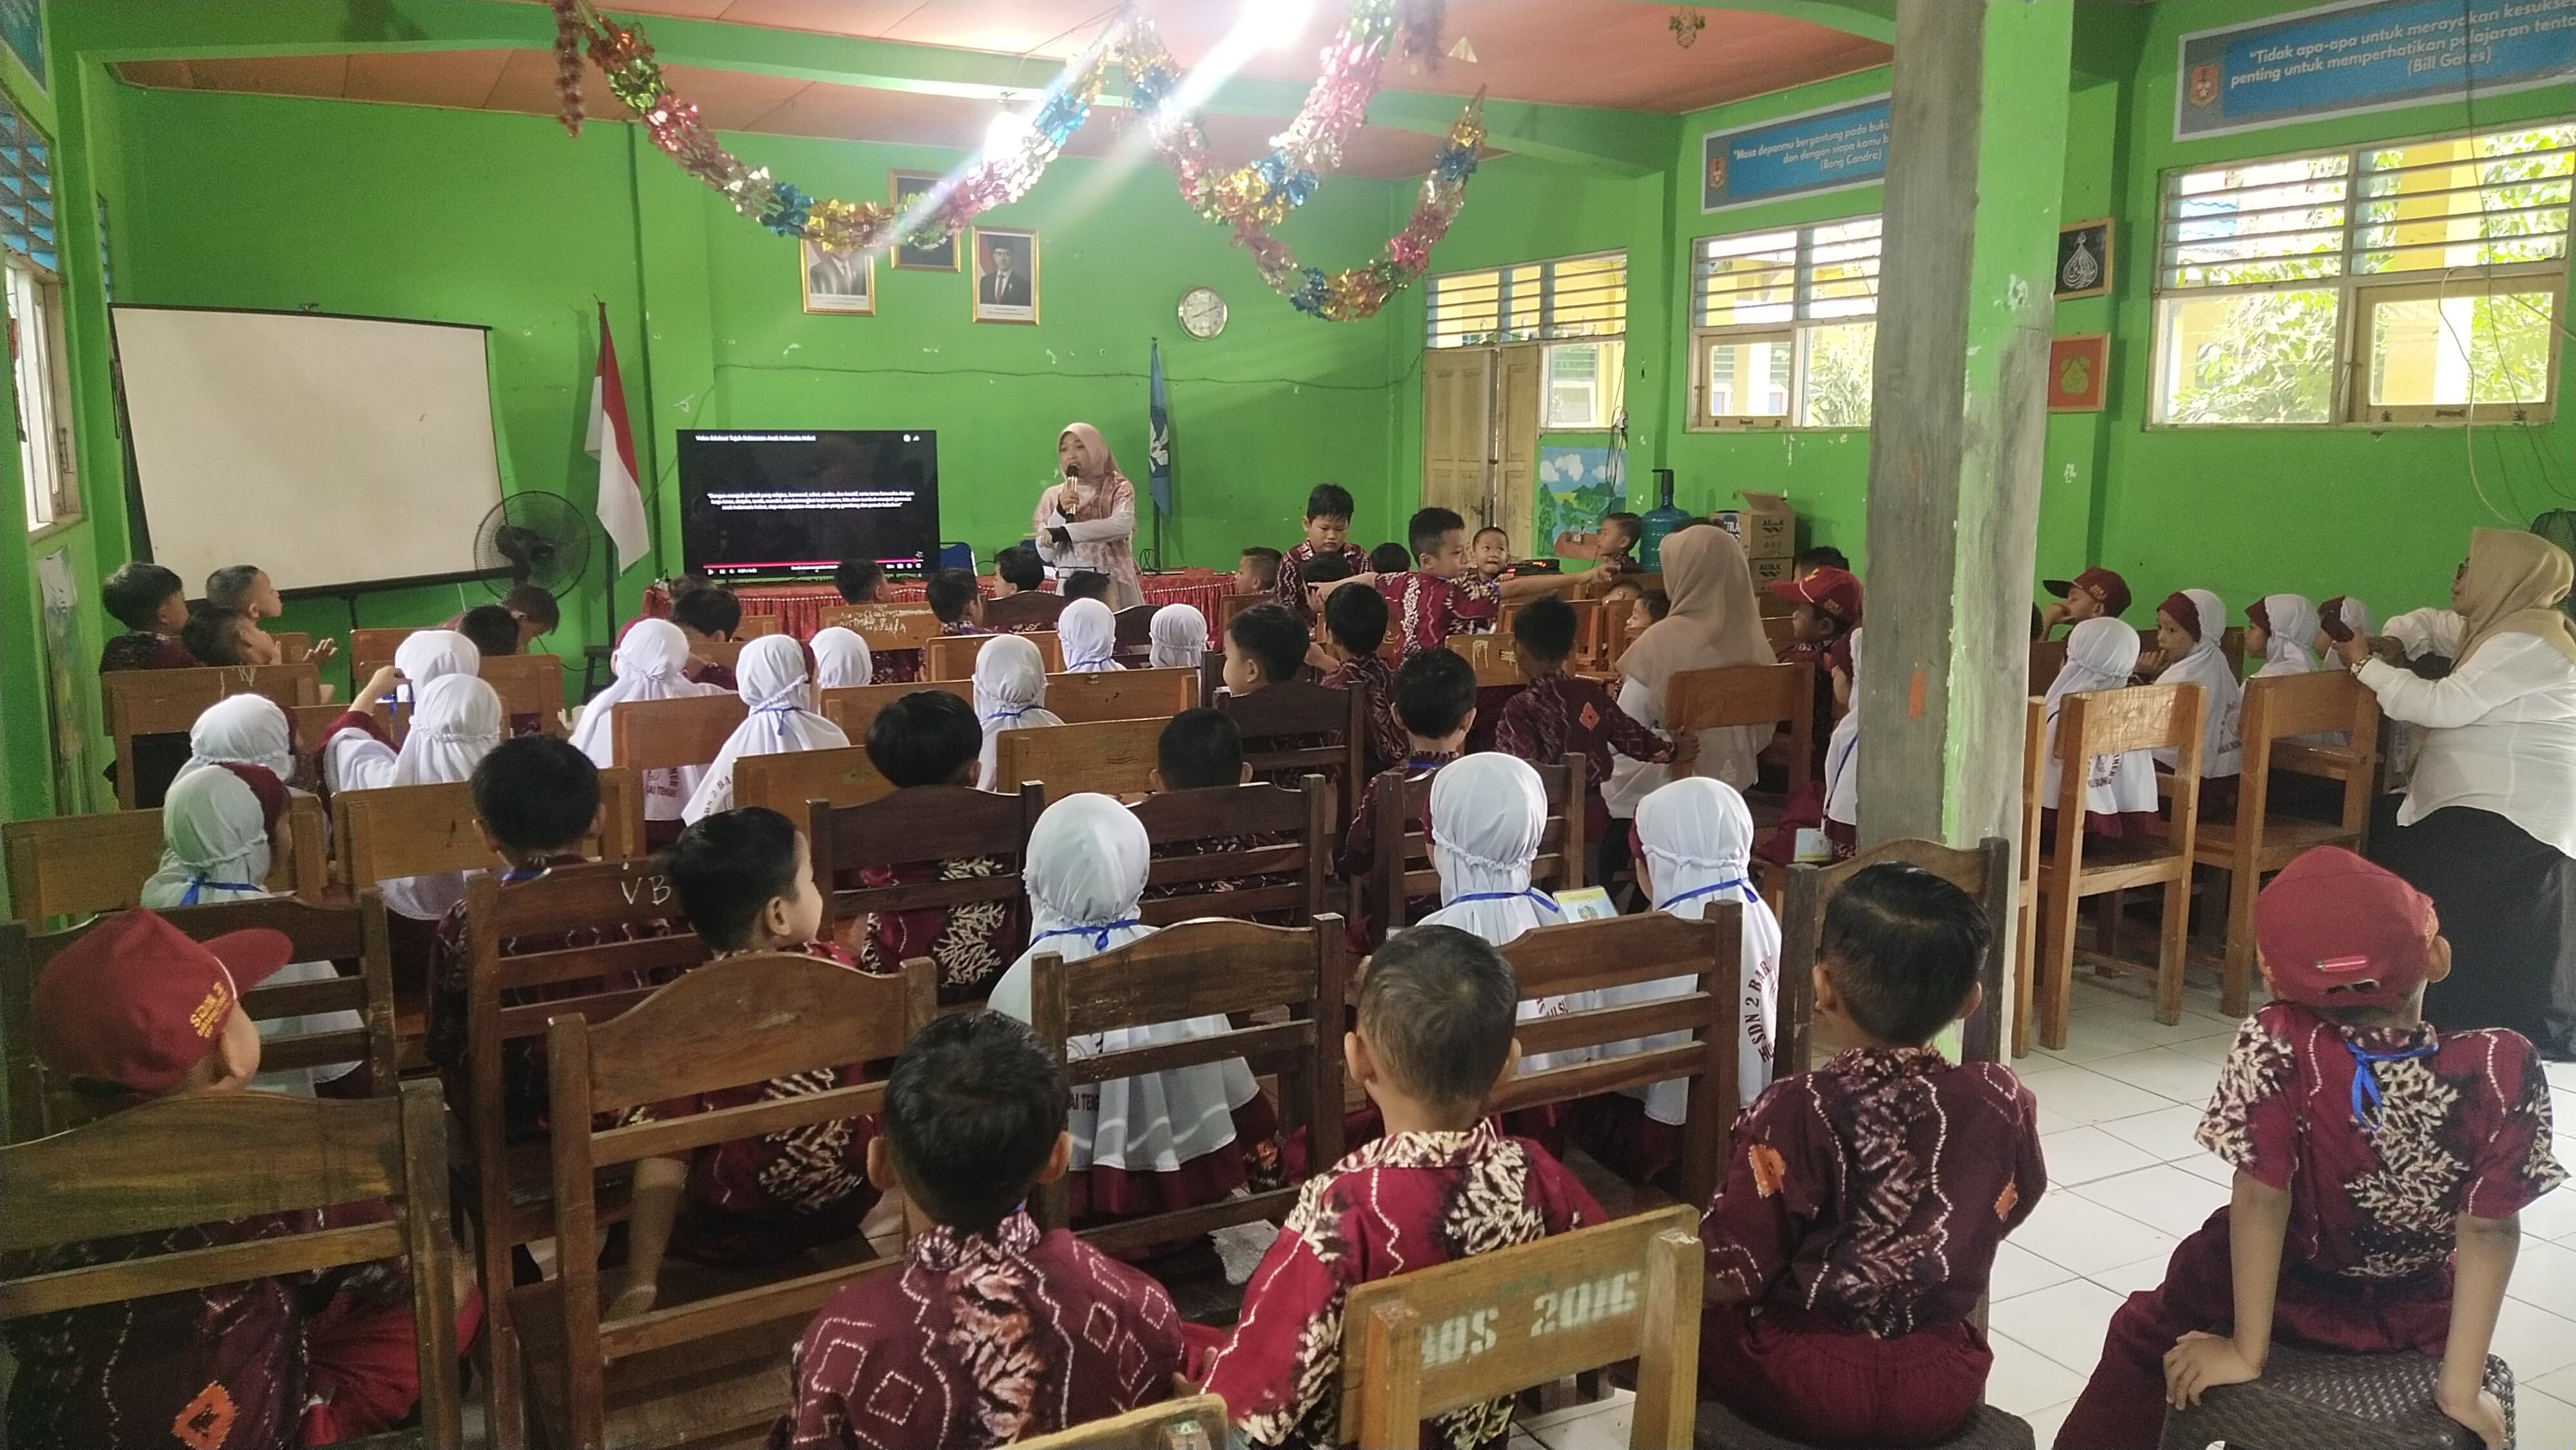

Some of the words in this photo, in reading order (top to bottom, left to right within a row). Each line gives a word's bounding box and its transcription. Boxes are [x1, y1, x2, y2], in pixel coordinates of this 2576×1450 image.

[2231, 67, 2281, 89] penting
[2284, 57, 2324, 76] untuk
[2327, 39, 2445, 69] memperhatikan
[2450, 24, 2530, 51] pelajaran
[2535, 15, 2576, 33] tenta
[2296, 35, 2357, 58] apa-apa
[2361, 24, 2403, 43] untuk
[2407, 55, 2436, 76] (Bill
[2440, 46, 2492, 68] Gates)
[1783, 153, 1799, 164] dan
[1800, 147, 1831, 160] dengan
[1832, 142, 1855, 154] siapa
[1857, 137, 1881, 148] kamu
[1796, 131, 1844, 148] bergantung
[1844, 124, 1867, 139] pada
[717, 775, 732, 790] BA
[1745, 997, 1759, 1008] 2
[1745, 1013, 1766, 1045] SDN
[1530, 1271, 1640, 1337] 2016
